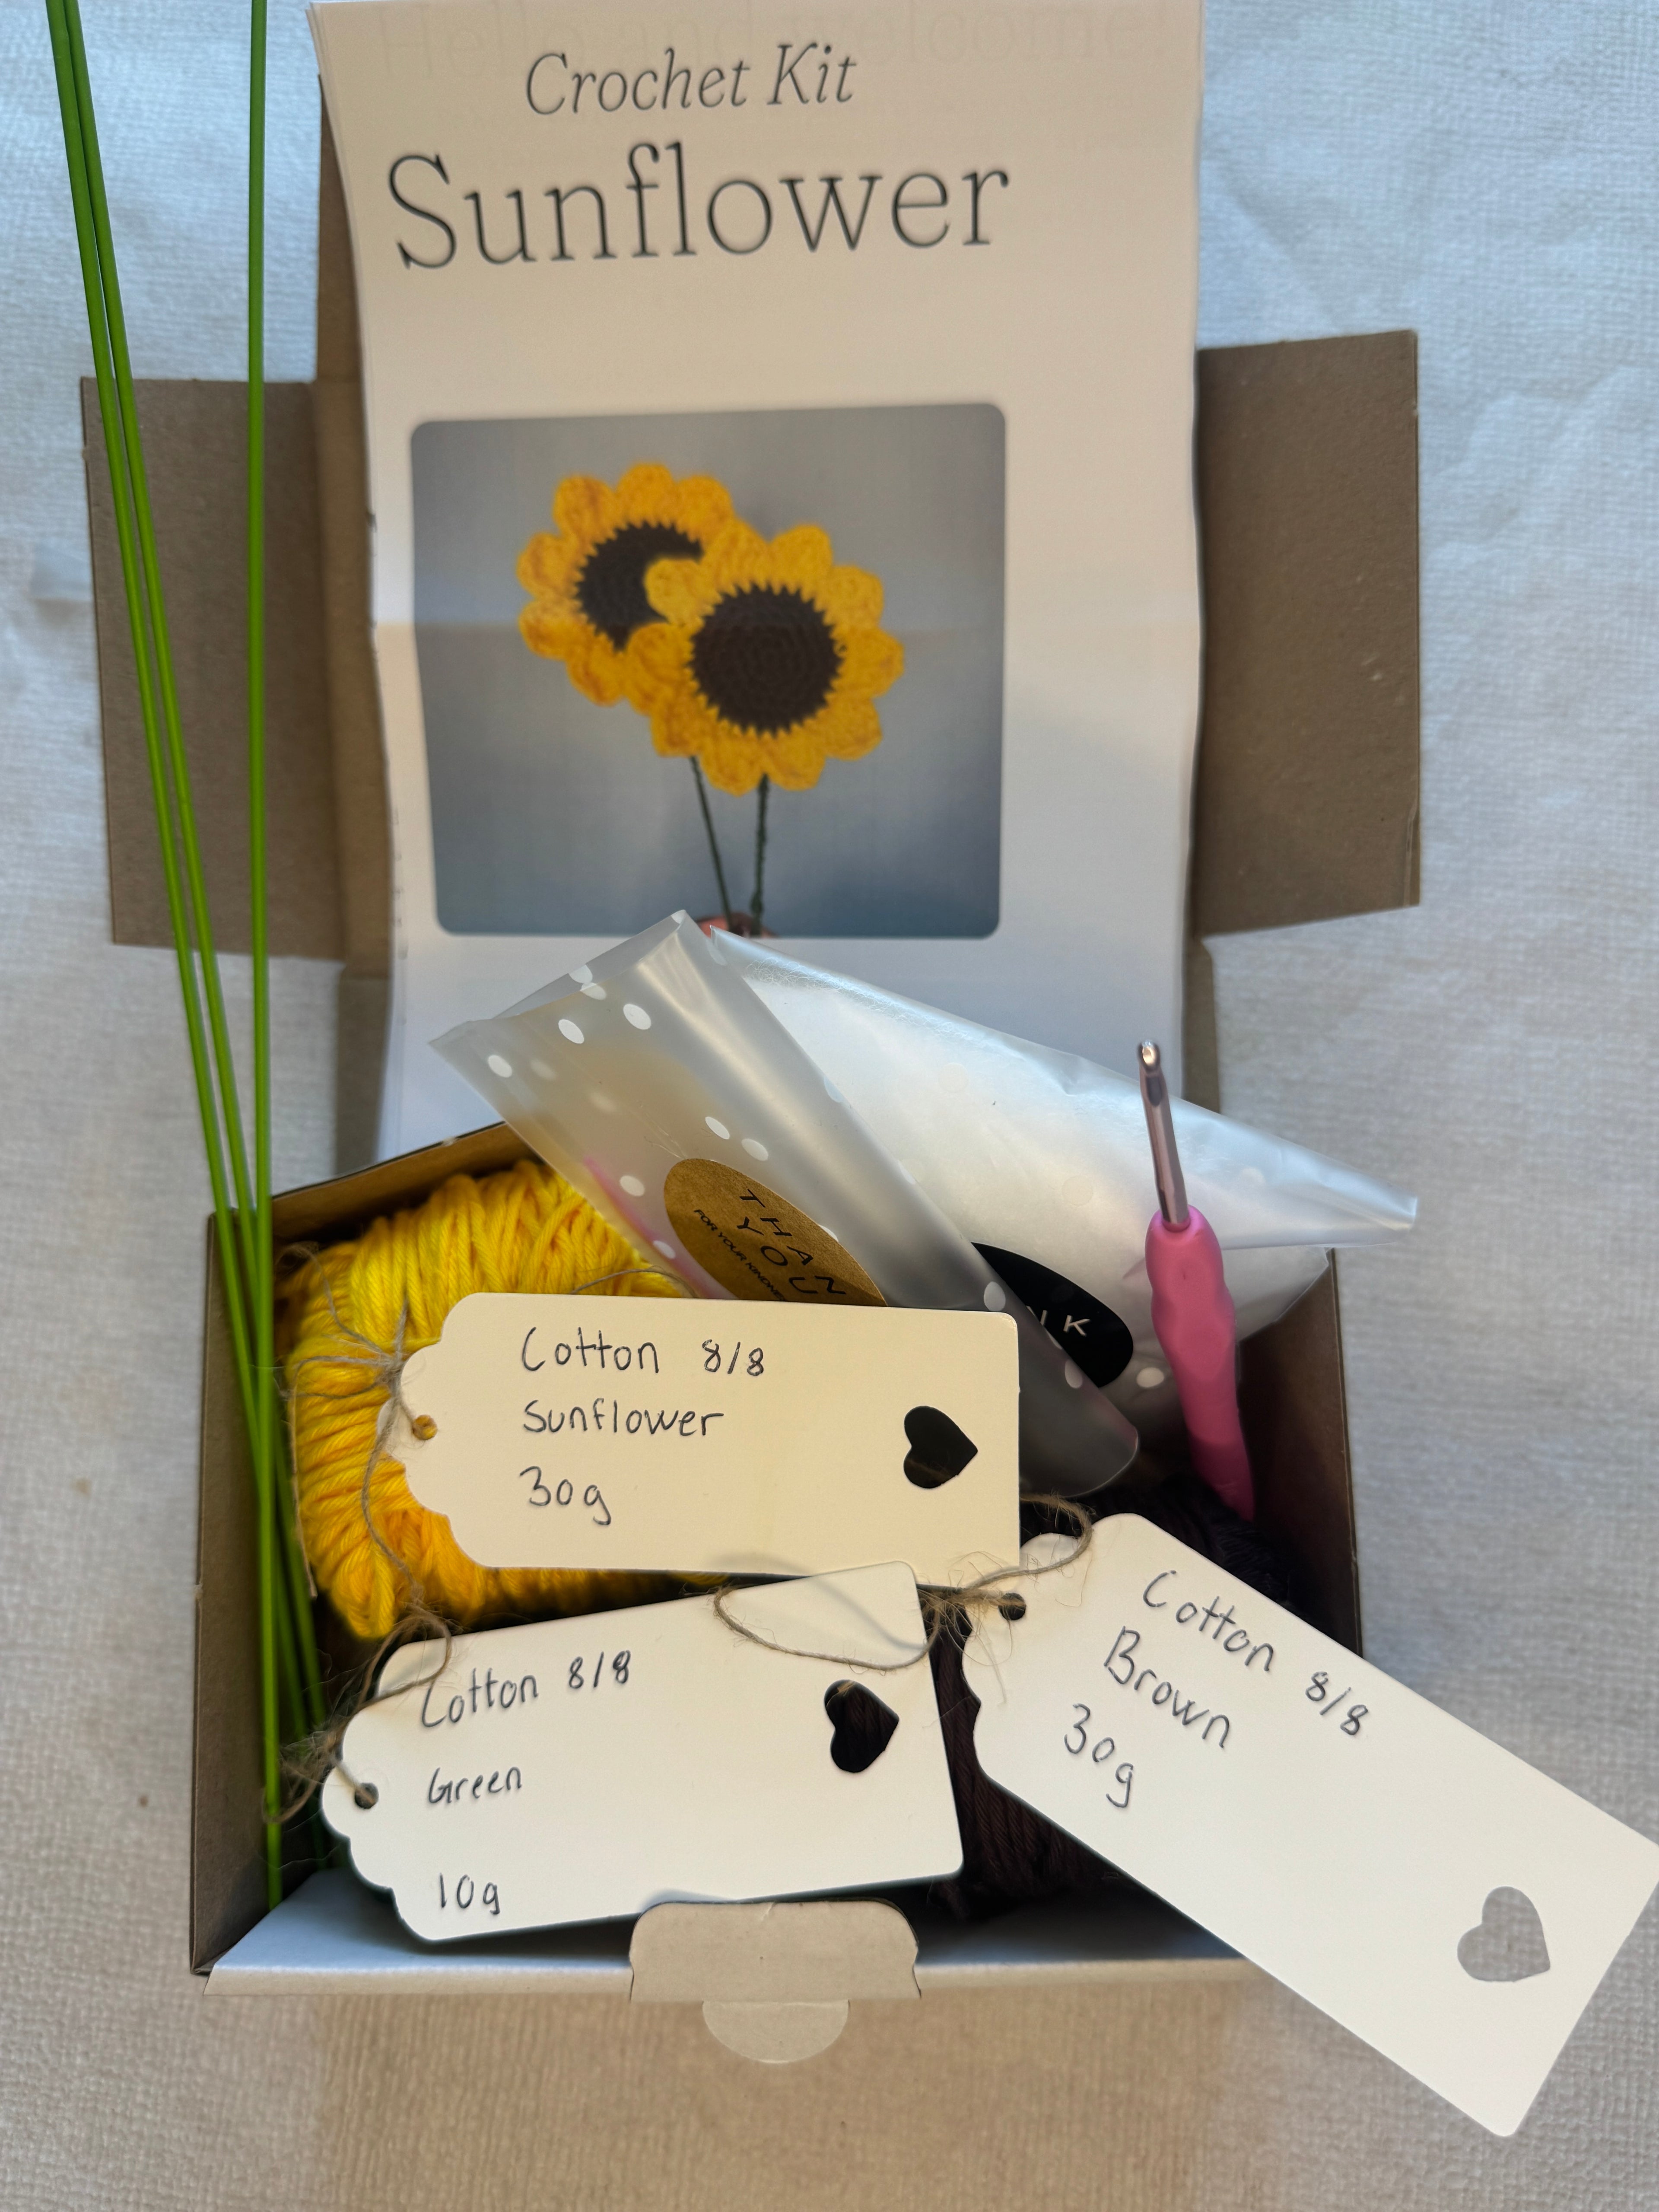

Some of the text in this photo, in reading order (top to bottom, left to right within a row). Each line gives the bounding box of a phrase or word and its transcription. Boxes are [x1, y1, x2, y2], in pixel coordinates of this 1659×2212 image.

[526, 42, 856, 115] Crochet Kit
[387, 140, 1010, 269] Sunflower
[693, 1209, 718, 1231] FOR
[718, 1232, 747, 1261] YOUR
[736, 1216, 819, 1294] YOU
[521, 1326, 765, 1377] Cotton 8/8
[519, 1465, 612, 1527] 30g
[421, 1649, 632, 1728] Cotton 8/8
[1103, 1625, 1230, 1748] Brown
[1142, 1570, 1369, 1736] Cotton 8/8
[426, 1767, 522, 1805] Green
[1064, 1703, 1135, 1809] 30g
[439, 1874, 501, 1916] 10g
